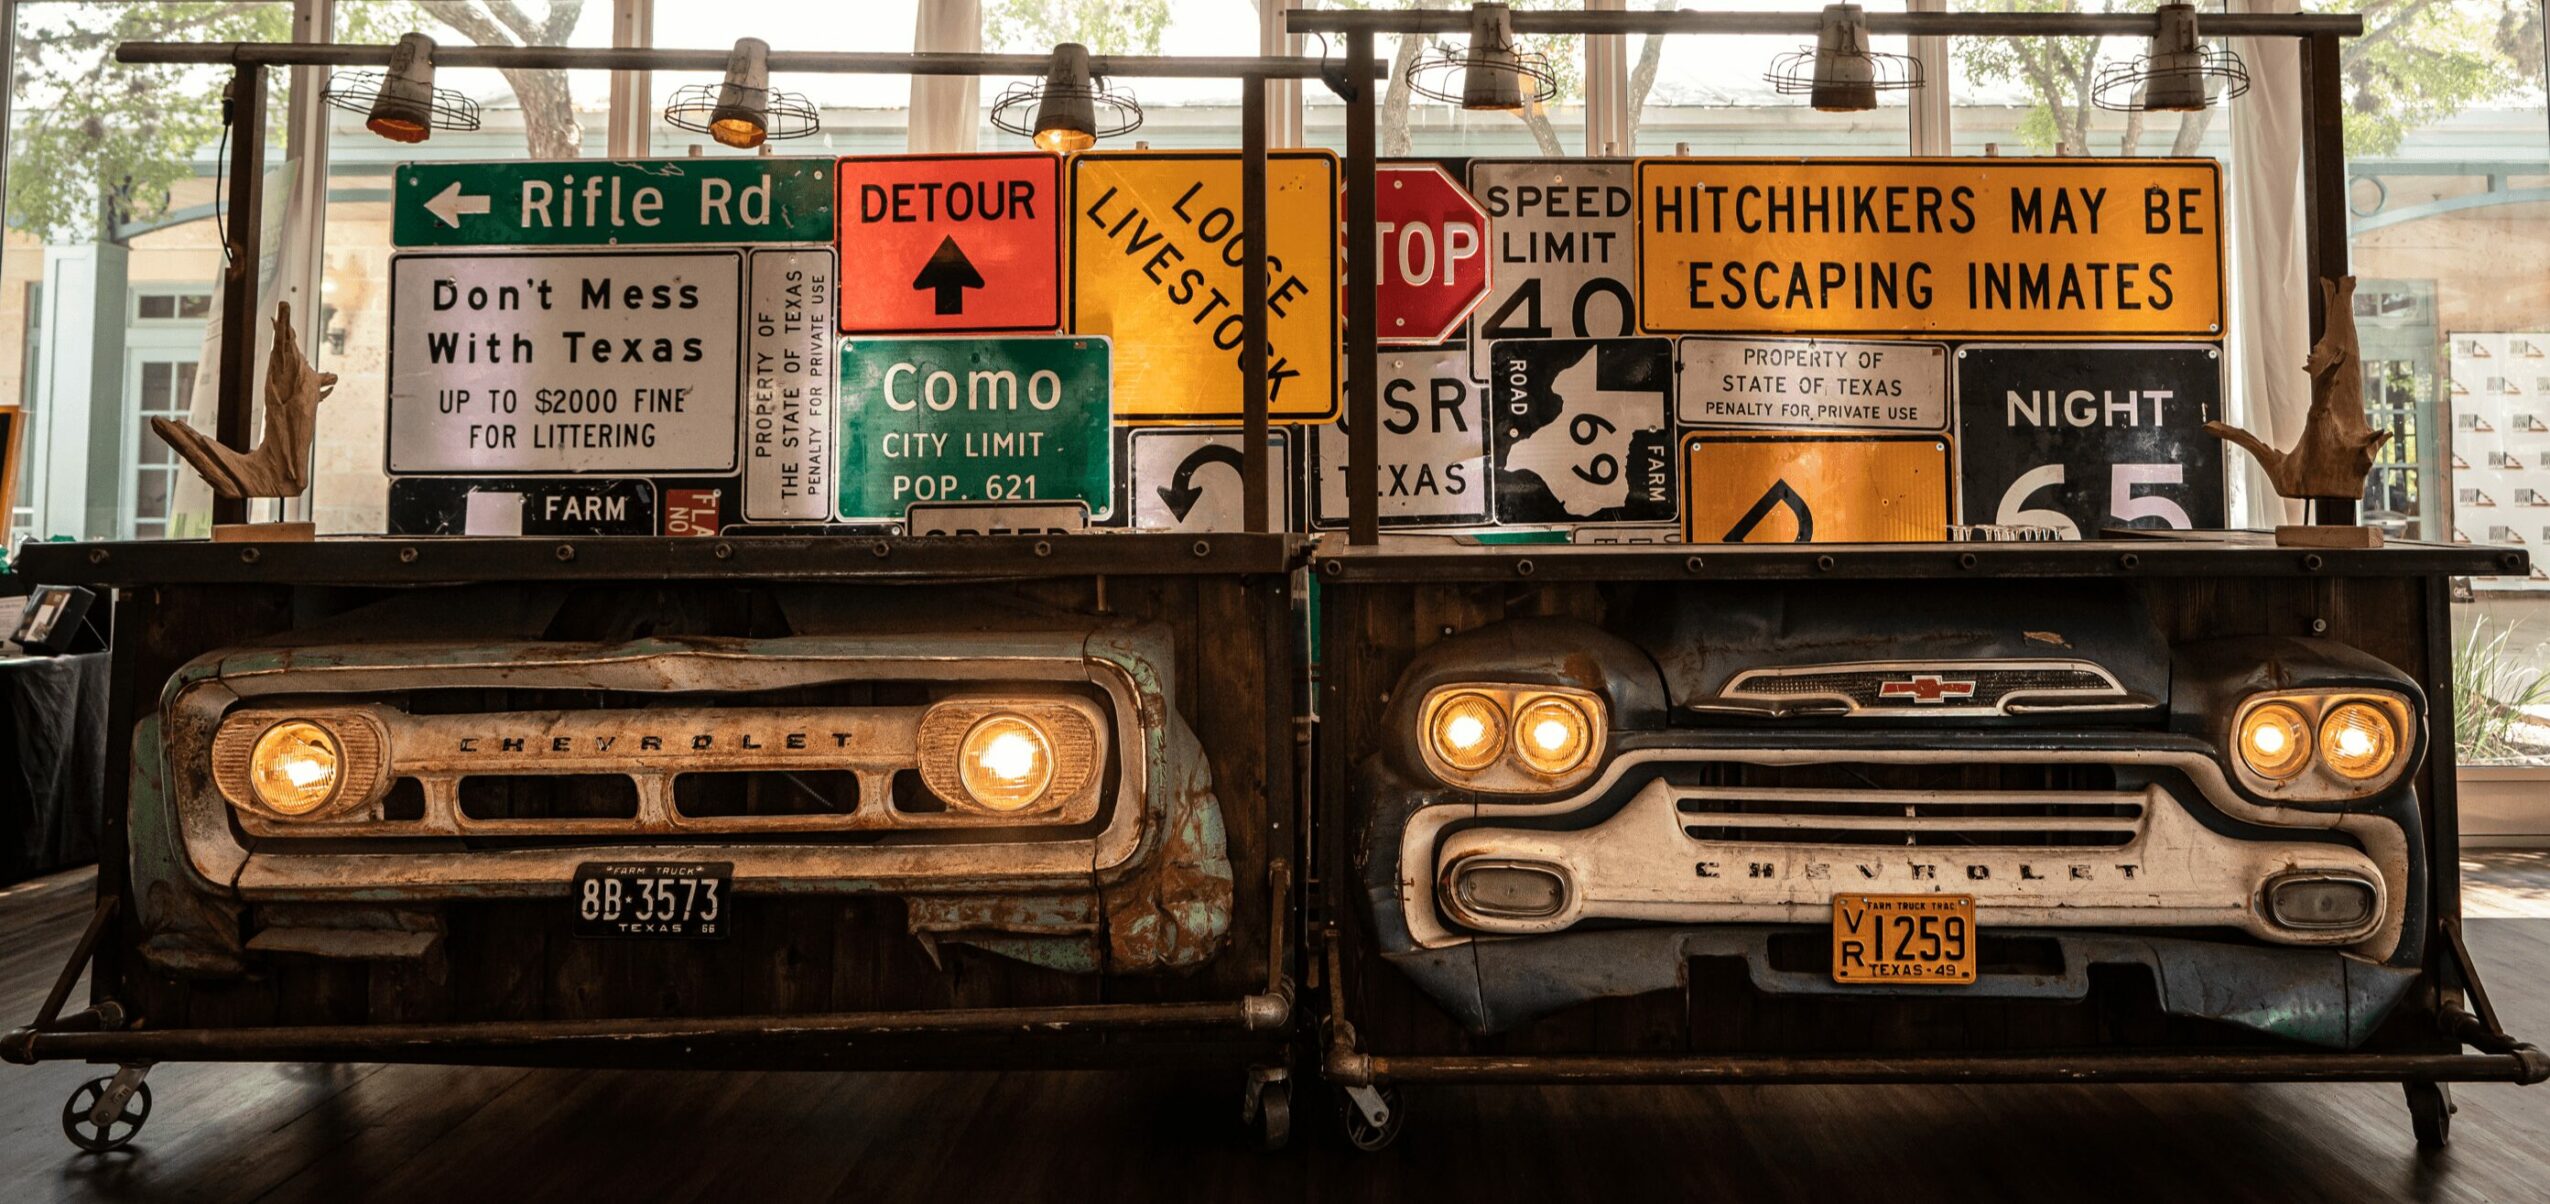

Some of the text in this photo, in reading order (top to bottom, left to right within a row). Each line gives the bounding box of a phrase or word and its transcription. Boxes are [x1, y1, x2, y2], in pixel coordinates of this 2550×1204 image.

[521, 174, 771, 228] Rifle Rd
[861, 179, 1036, 224] DETOUR
[1486, 186, 1632, 218] SPEED
[1656, 185, 2203, 236] HITCHHIKERS MAY BE
[1342, 221, 1480, 286] TOP
[1503, 232, 1616, 264] LIMIT
[433, 277, 699, 311] Don't Mess
[1690, 261, 2173, 311] ESCAPING INMATES
[1481, 277, 1635, 339] 40
[428, 330, 704, 365] With Texas
[1744, 348, 1883, 369] PROPERTY OF
[756, 312, 775, 457] PROPERTY OF
[781, 270, 802, 499] THE STATE OF TEXAS
[808, 275, 825, 495] PENALTY FOR PRIVATE USE
[883, 363, 1062, 411] Como
[1510, 359, 1528, 415] ROAD
[1723, 375, 1902, 396] STATE OF TEXAS
[439, 388, 685, 417] UP TO $2000 FINE
[1336, 378, 1468, 436] SR
[1706, 401, 1918, 420] PENALTY FOR PRIVATE USE
[2007, 390, 2173, 427] NIGHT
[470, 423, 656, 449] FOR LITTERING
[882, 431, 1043, 459] CITY LIMIT
[1569, 413, 1618, 485] 69
[894, 474, 1036, 501] POP. 621
[1647, 446, 1666, 501] FARM
[545, 496, 626, 521] FARM
[668, 507, 689, 532] NO
[460, 733, 853, 753] CHEVROLET
[614, 866, 694, 875] FARM TRUCK
[1695, 862, 2138, 881] CHEVROLET
[1867, 902, 1955, 910] FARM TRUCK TRAC
[618, 924, 682, 933] TEXAS
[1875, 915, 1966, 961] 1259
